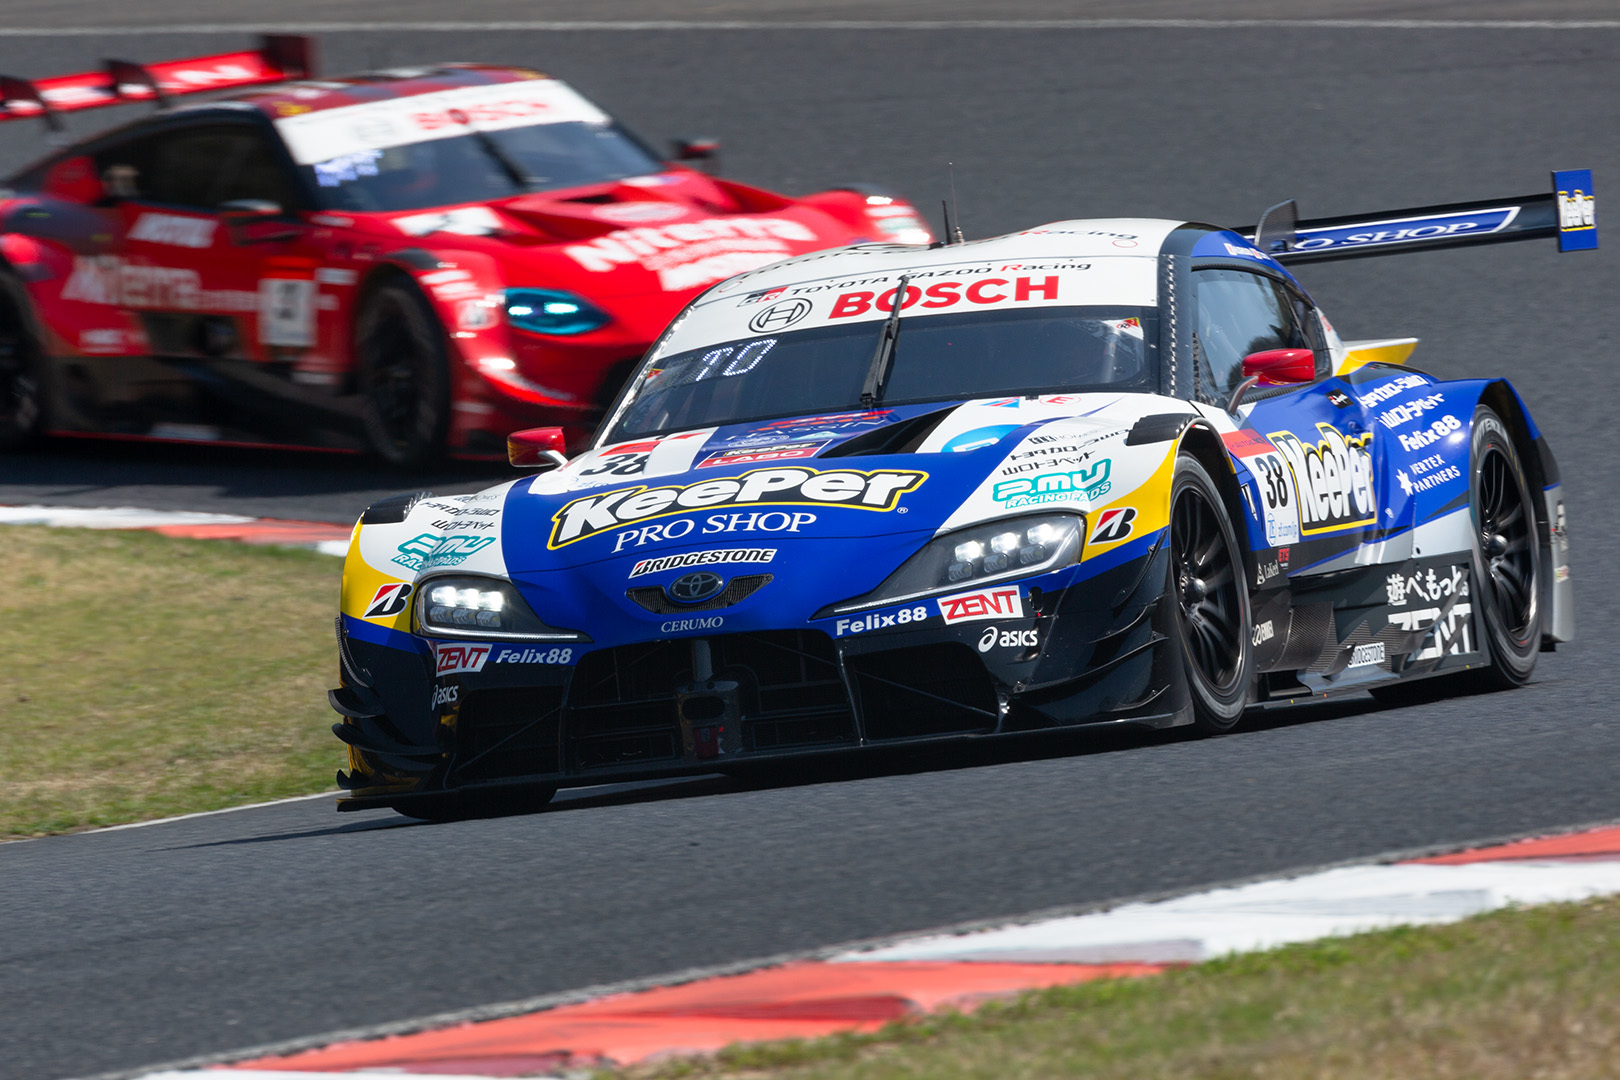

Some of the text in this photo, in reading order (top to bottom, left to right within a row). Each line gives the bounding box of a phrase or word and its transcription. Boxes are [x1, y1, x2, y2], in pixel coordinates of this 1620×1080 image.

[1019, 230, 1139, 240] Racing
[1342, 223, 1478, 245] SHOP
[791, 276, 889, 296] TOYOTA
[898, 267, 992, 281] GAZOO
[1001, 263, 1092, 271] Racing
[828, 275, 1060, 320] BOSCH
[1398, 415, 1461, 452] Felix88
[712, 450, 805, 466] LABO
[722, 442, 817, 457] KeePer
[579, 453, 651, 476] 38
[1270, 426, 1376, 529] KeePer
[1255, 454, 1288, 509] 38
[1412, 465, 1461, 493] PARTNERS
[550, 468, 925, 546] KeePer
[1005, 481, 1112, 509] RACING PADS
[611, 512, 817, 553] PRO SHOP
[629, 549, 777, 579] BRIDGESTONE
[661, 616, 724, 634] CERUMO
[836, 590, 1018, 636] Felix88 ZENT
[999, 630, 1038, 647] asics
[437, 647, 573, 670] ZENT Felix88
[437, 684, 459, 705] asics
